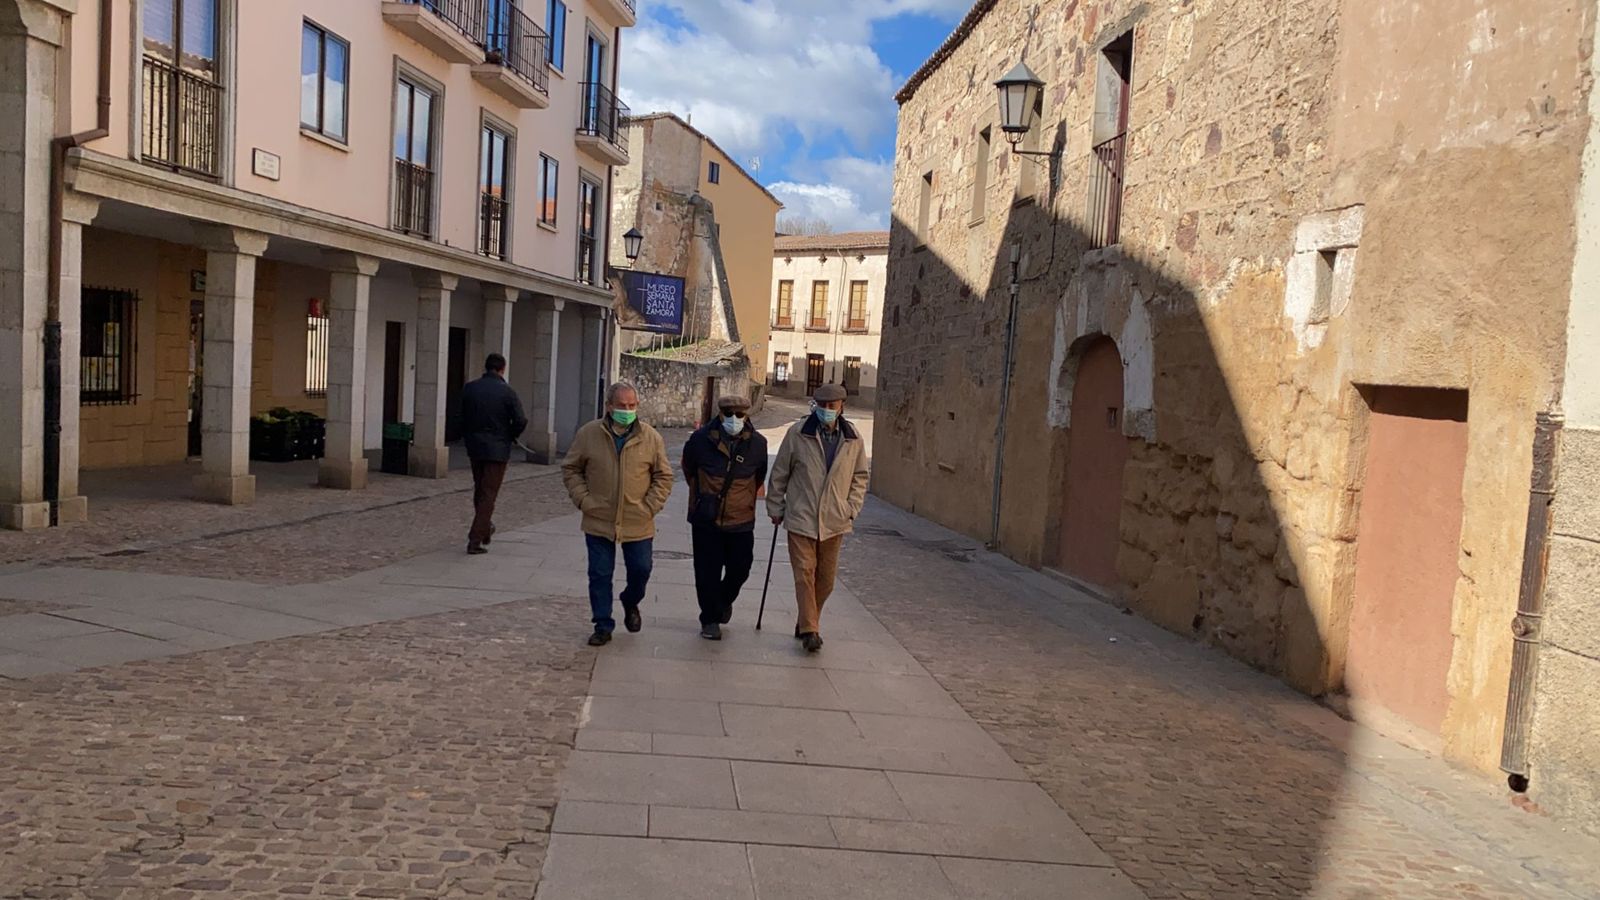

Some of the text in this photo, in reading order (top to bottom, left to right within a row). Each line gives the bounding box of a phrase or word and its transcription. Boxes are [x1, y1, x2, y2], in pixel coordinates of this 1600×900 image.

[647, 283, 676, 295] MUSEO
[647, 291, 675, 301] SEMANA
[646, 299, 675, 310] SANTA
[646, 307, 674, 317] ZAMORA
